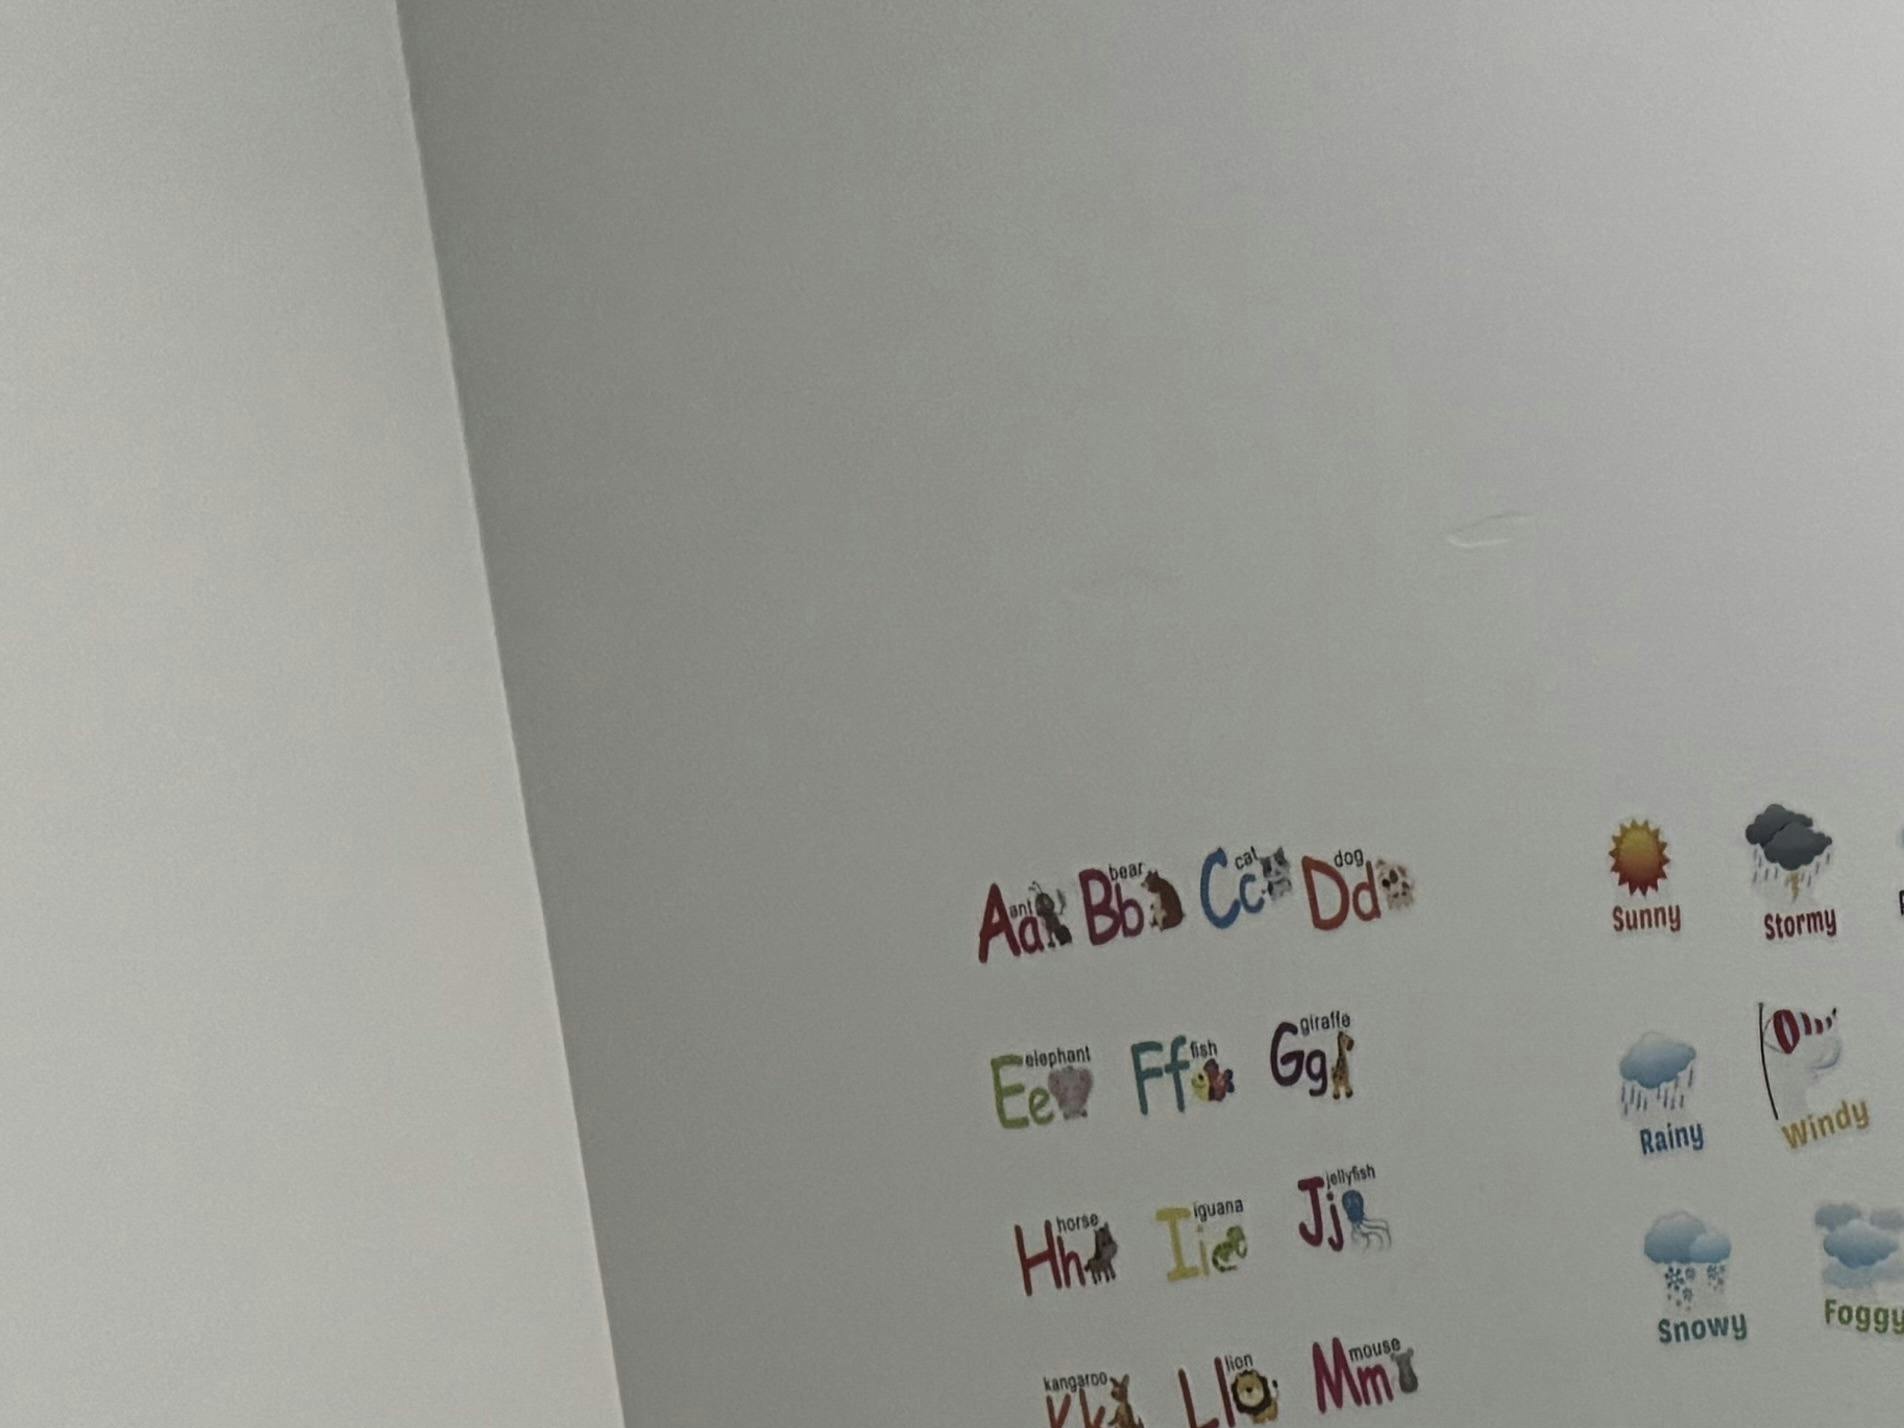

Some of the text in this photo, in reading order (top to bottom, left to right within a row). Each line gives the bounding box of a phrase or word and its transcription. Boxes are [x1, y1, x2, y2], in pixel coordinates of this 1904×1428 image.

[1109, 862, 1143, 881] bear
[1235, 846, 1259, 870] cat
[1334, 849, 1364, 869] dog
[1200, 846, 1264, 929] Cc
[1301, 855, 1381, 930] Dd
[978, 883, 1044, 963] Aa
[1079, 868, 1144, 946] Bb
[1612, 903, 1682, 932] Sunny
[1764, 907, 1837, 941] Stormy
[1300, 1010, 1351, 1036] giraffe
[1025, 1045, 1091, 1068] elephant
[1190, 1039, 1217, 1058] fish
[1269, 1021, 1327, 1096] Gg
[1131, 1034, 1190, 1115] Ff
[990, 1054, 1055, 1129] Ee
[1640, 1122, 1705, 1156] Rainy
[1781, 1099, 1871, 1150] Windy
[1325, 1163, 1375, 1189] jellyfish
[1056, 1212, 1099, 1234] horse
[1193, 1199, 1244, 1221] iguana
[1297, 1176, 1343, 1252] Jj
[1014, 1219, 1086, 1296] Hh
[1155, 1207, 1209, 1282] Ii
[1658, 1312, 1747, 1345] Snowy
[1225, 1352, 1253, 1372] lion
[1348, 1338, 1401, 1362] mouse
[1043, 1371, 1108, 1392] kangaroo
[1312, 1337, 1394, 1414] Mm
